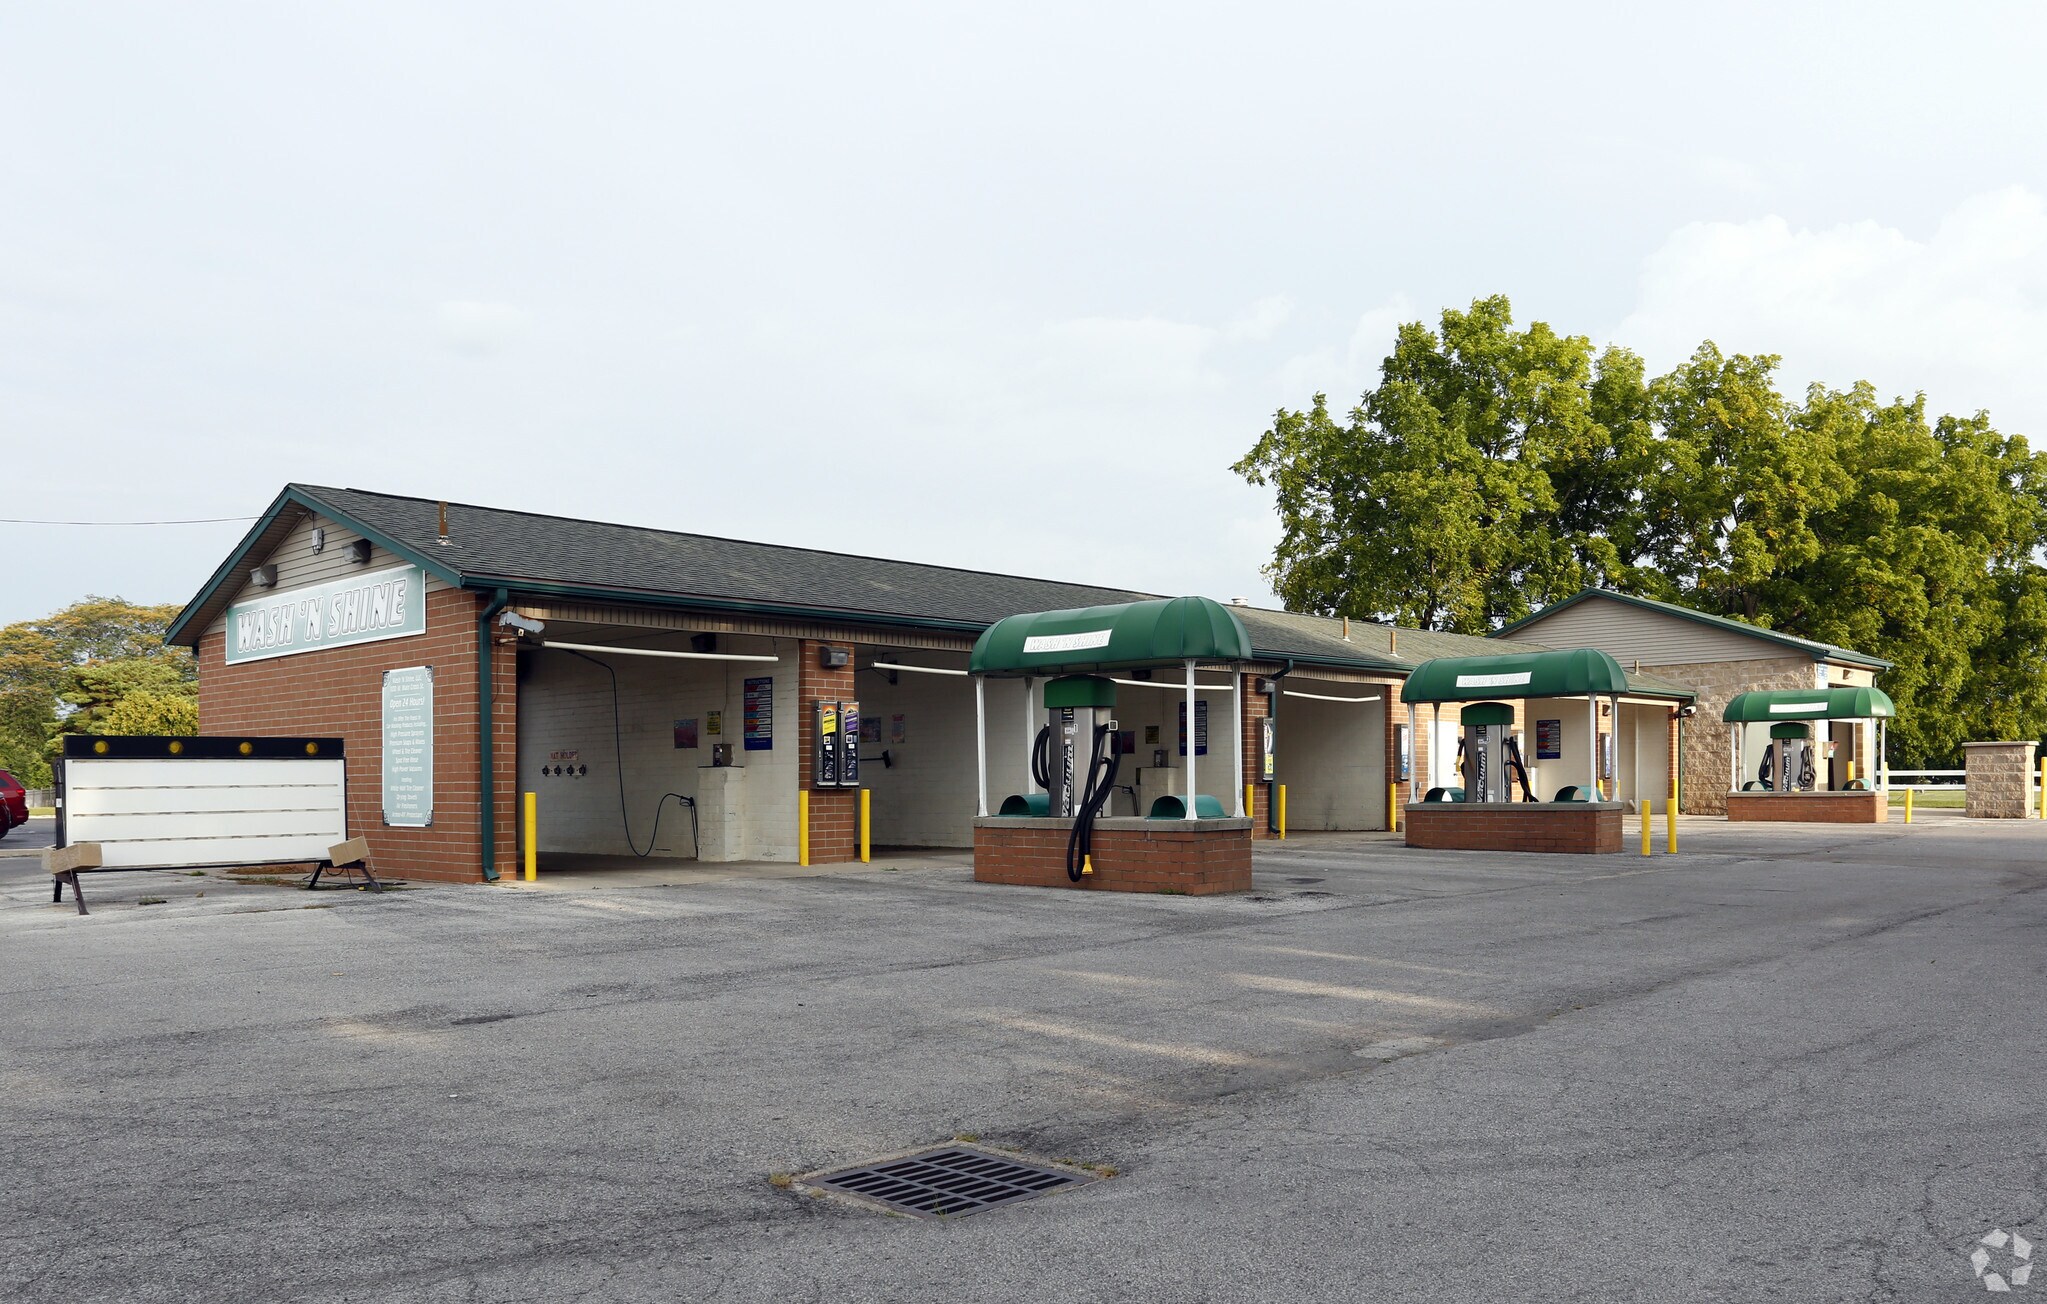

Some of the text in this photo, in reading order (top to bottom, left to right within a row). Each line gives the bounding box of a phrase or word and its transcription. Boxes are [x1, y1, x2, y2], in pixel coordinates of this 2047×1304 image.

[237, 579, 407, 653] WASH 'N SHINE
[1030, 638, 1060, 650] WASH
[1073, 633, 1106, 648] SHINE
[390, 695, 425, 709] Open 24 Hours!
